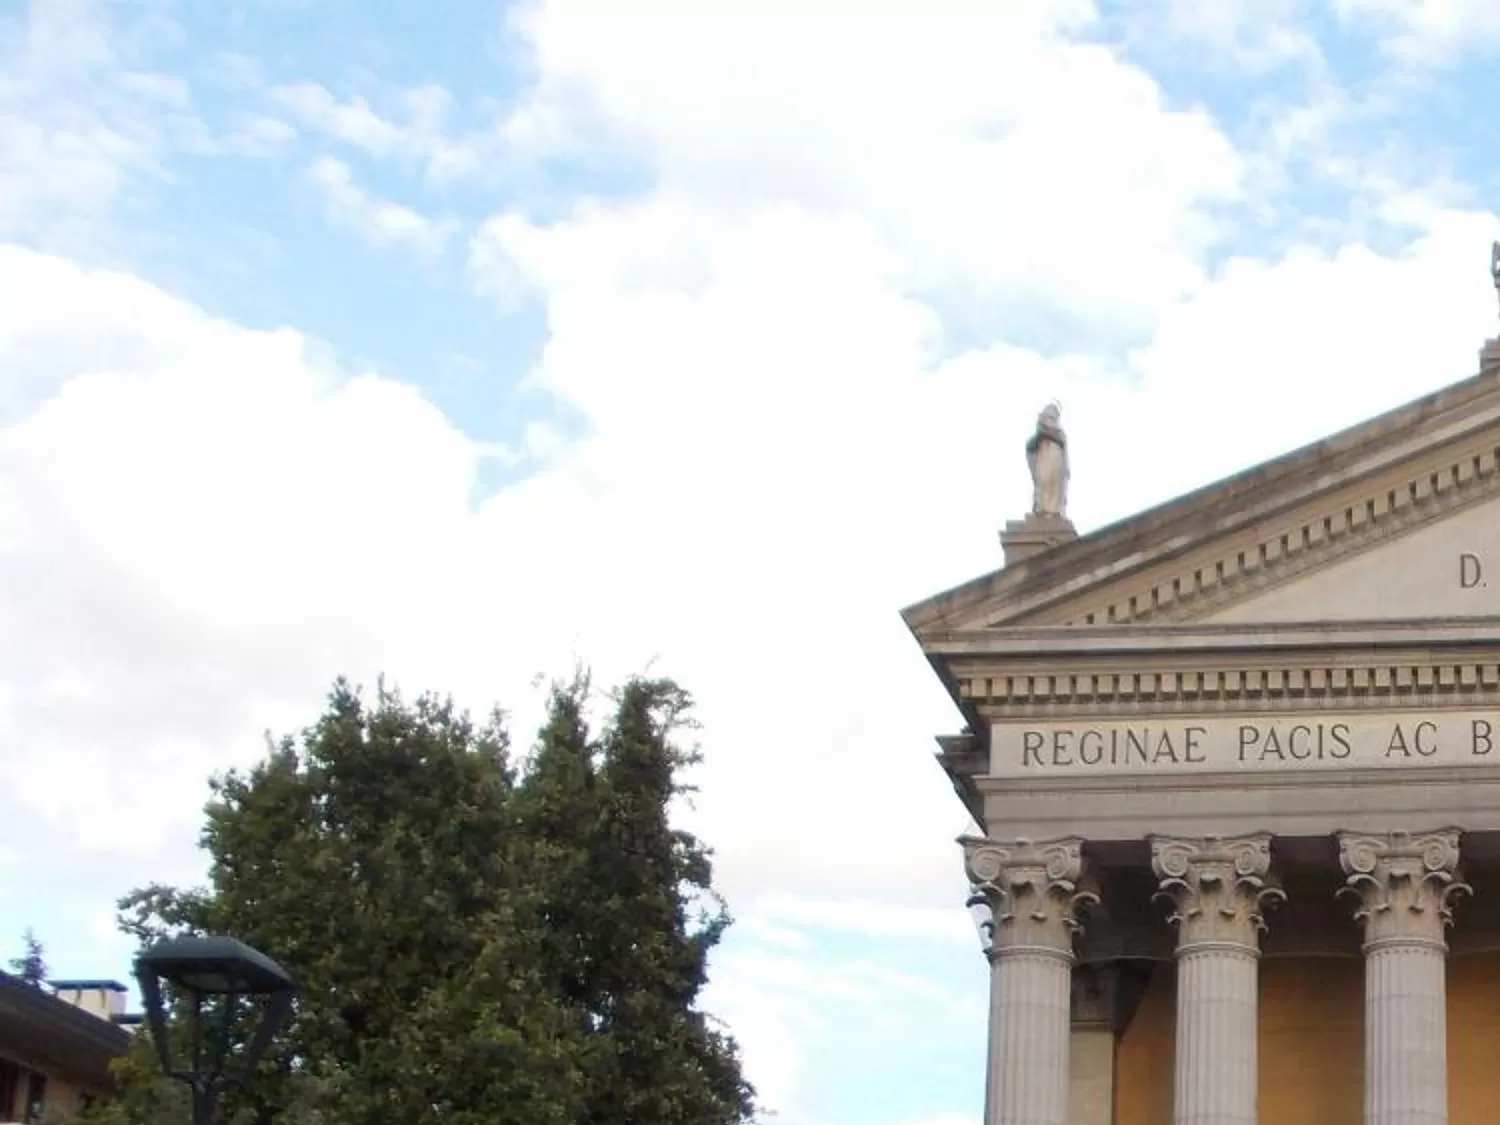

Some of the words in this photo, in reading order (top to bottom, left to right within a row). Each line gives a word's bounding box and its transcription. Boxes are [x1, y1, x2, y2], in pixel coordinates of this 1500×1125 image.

[1022, 728, 1206, 767] REGINAE
[1238, 723, 1352, 762] PACIS
[1386, 721, 1438, 757] AC
